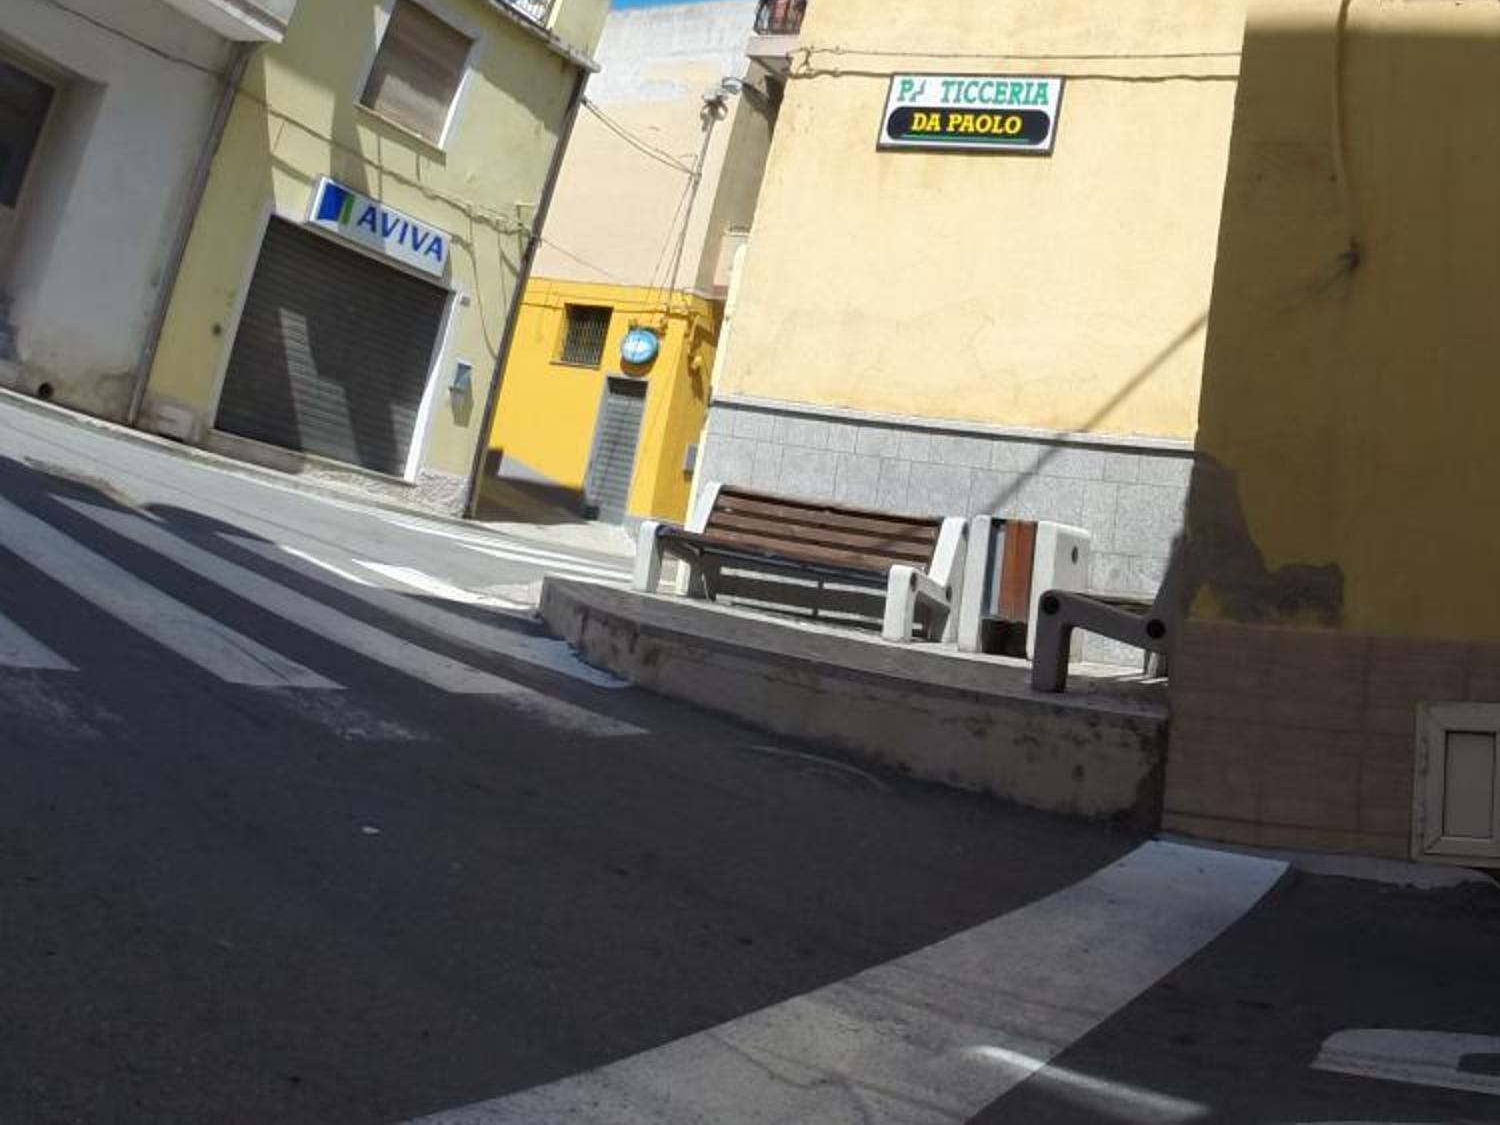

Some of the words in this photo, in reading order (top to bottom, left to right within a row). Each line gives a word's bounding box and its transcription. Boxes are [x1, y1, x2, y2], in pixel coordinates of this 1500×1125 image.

[897, 79, 1049, 105] PTICCERIA
[911, 112, 941, 131] DA
[946, 114, 1022, 134] PAOLO
[357, 204, 443, 262] AVIVA
